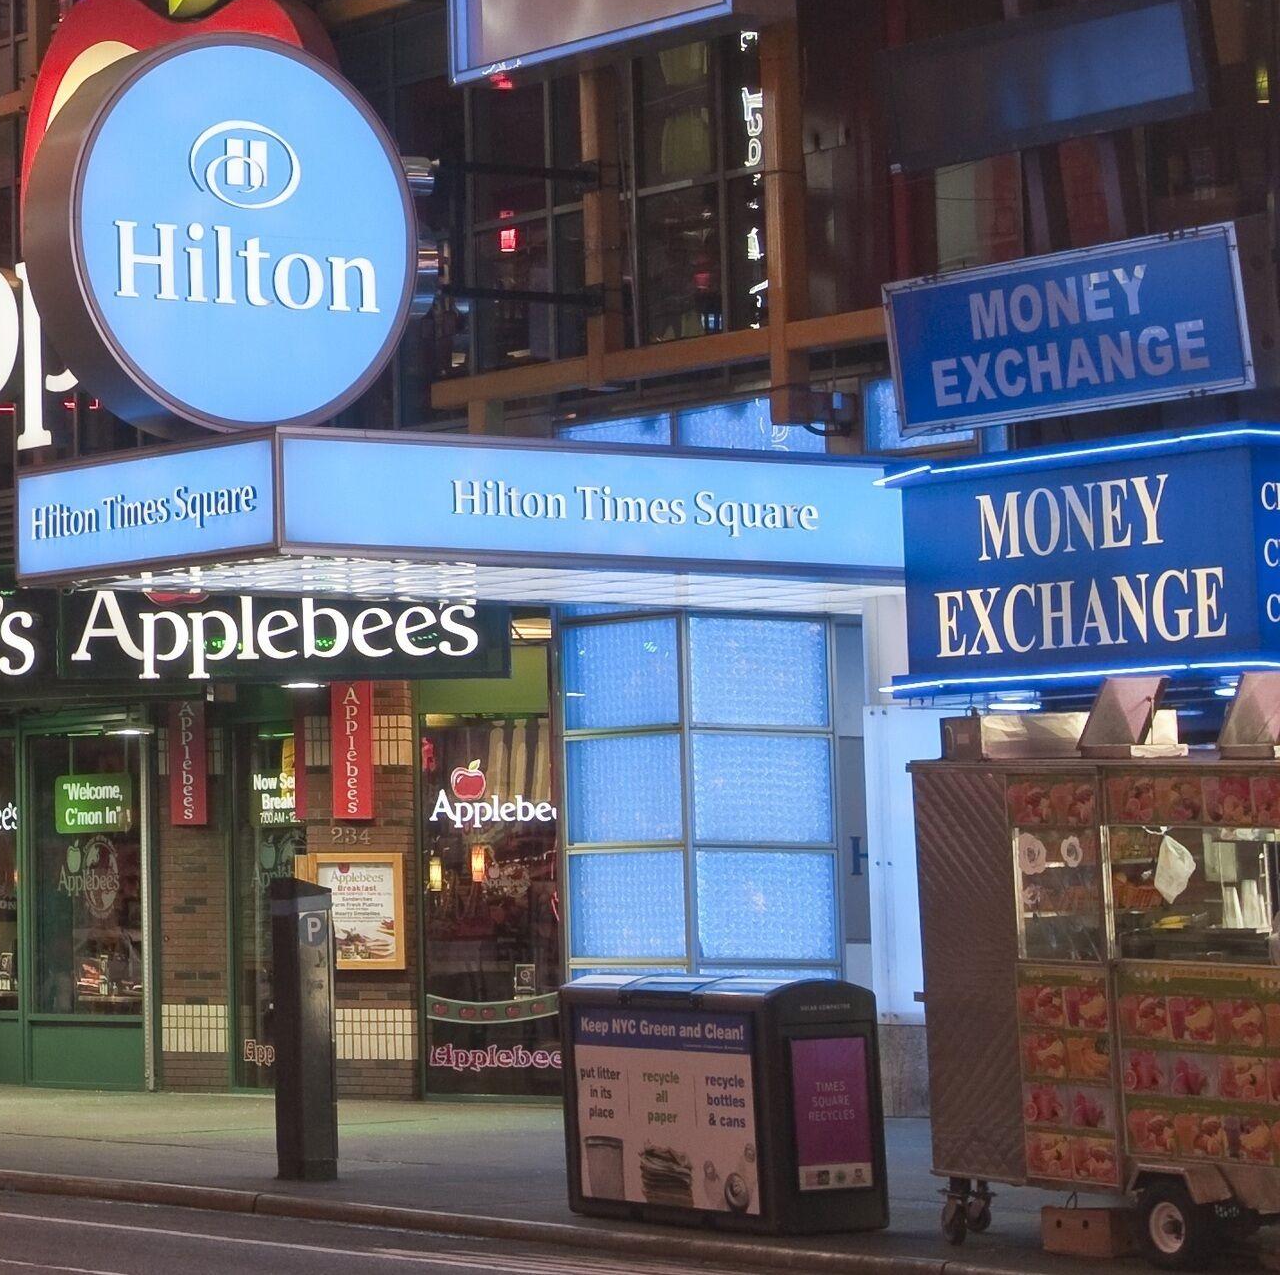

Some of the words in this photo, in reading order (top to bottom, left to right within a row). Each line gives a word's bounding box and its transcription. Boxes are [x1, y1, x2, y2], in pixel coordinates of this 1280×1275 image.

[113, 220, 380, 314] Hilton
[969, 265, 1147, 341] MONEY
[931, 320, 1210, 408] EXCHANGE
[31, 502, 99, 541] Hilton
[103, 496, 168, 530] Times
[173, 483, 257, 524] Square
[451, 478, 567, 521] Hilton
[574, 485, 687, 527] Times
[692, 493, 819, 538] Square
[976, 473, 1169, 562] MONEY
[934, 567, 1227, 657] EXCHANGE
[71, 591, 477, 679] Applebee's
[342, 686, 361, 814] Applebee's
[178, 702, 195, 820] Applebee's
[253, 774, 278, 791] Now
[66, 807, 103, 826] C'mon
[331, 827, 370, 845] 234
[307, 918, 321, 942] P
[581, 1016, 608, 1038] Keep
[612, 1018, 636, 1035] NYC
[640, 1020, 676, 1037] Green
[679, 1024, 701, 1039] and
[705, 1023, 744, 1041] Clean!
[580, 1067, 596, 1080] put
[597, 1066, 621, 1080] litter
[642, 1071, 680, 1086] recycle
[705, 1074, 745, 1090] recycle
[590, 1085, 599, 1098] in
[600, 1086, 612, 1099] its
[815, 1081, 846, 1092] TIMES
[655, 1090, 668, 1103] all
[707, 1093, 745, 1108] bottles
[812, 1095, 850, 1107] SQUARE
[589, 1106, 615, 1120] place
[648, 1111, 678, 1125] paper
[708, 1113, 717, 1126] &
[720, 1115, 746, 1128] cans
[808, 1109, 855, 1121] RECYCLES
